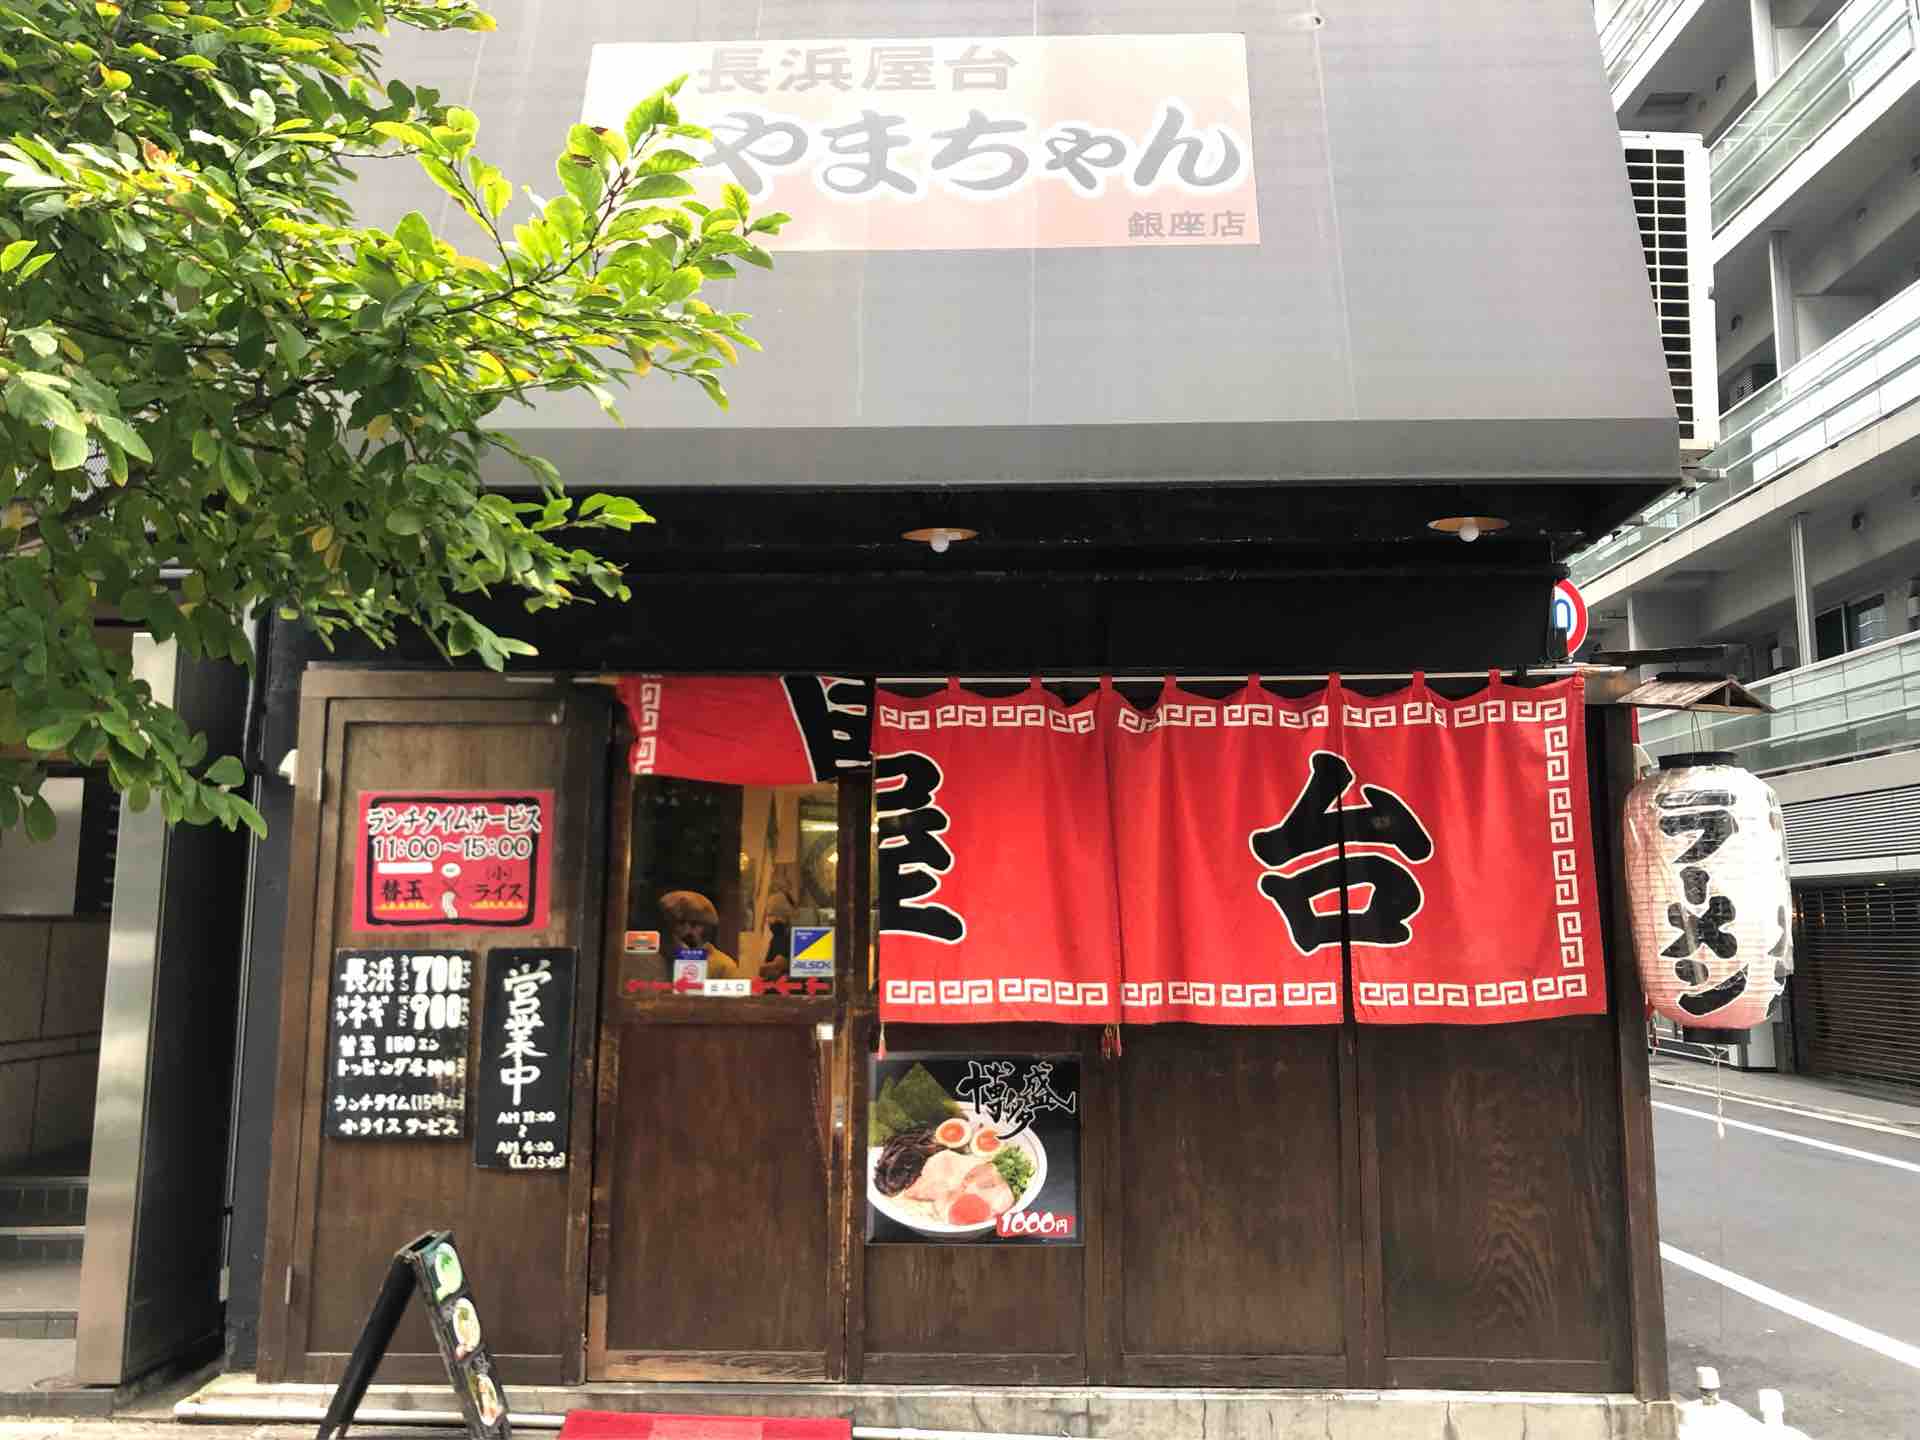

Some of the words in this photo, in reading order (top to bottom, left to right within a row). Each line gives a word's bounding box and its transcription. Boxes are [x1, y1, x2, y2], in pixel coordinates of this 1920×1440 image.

[697, 47, 1018, 94] 長浜屋台
[698, 107, 1241, 195] やまちゃん
[1127, 209, 1247, 239] 銀座店
[367, 803, 543, 836] ランチタイムサービス
[474, 882, 525, 901] ライス
[1655, 789, 1749, 1017] ラーメン
[340, 957, 395, 993] 長浜
[500, 959, 552, 1106] 営業中
[497, 1111, 520, 1124] AM
[496, 1141, 520, 1154] AM
[1001, 1211, 1070, 1234] 1000円
